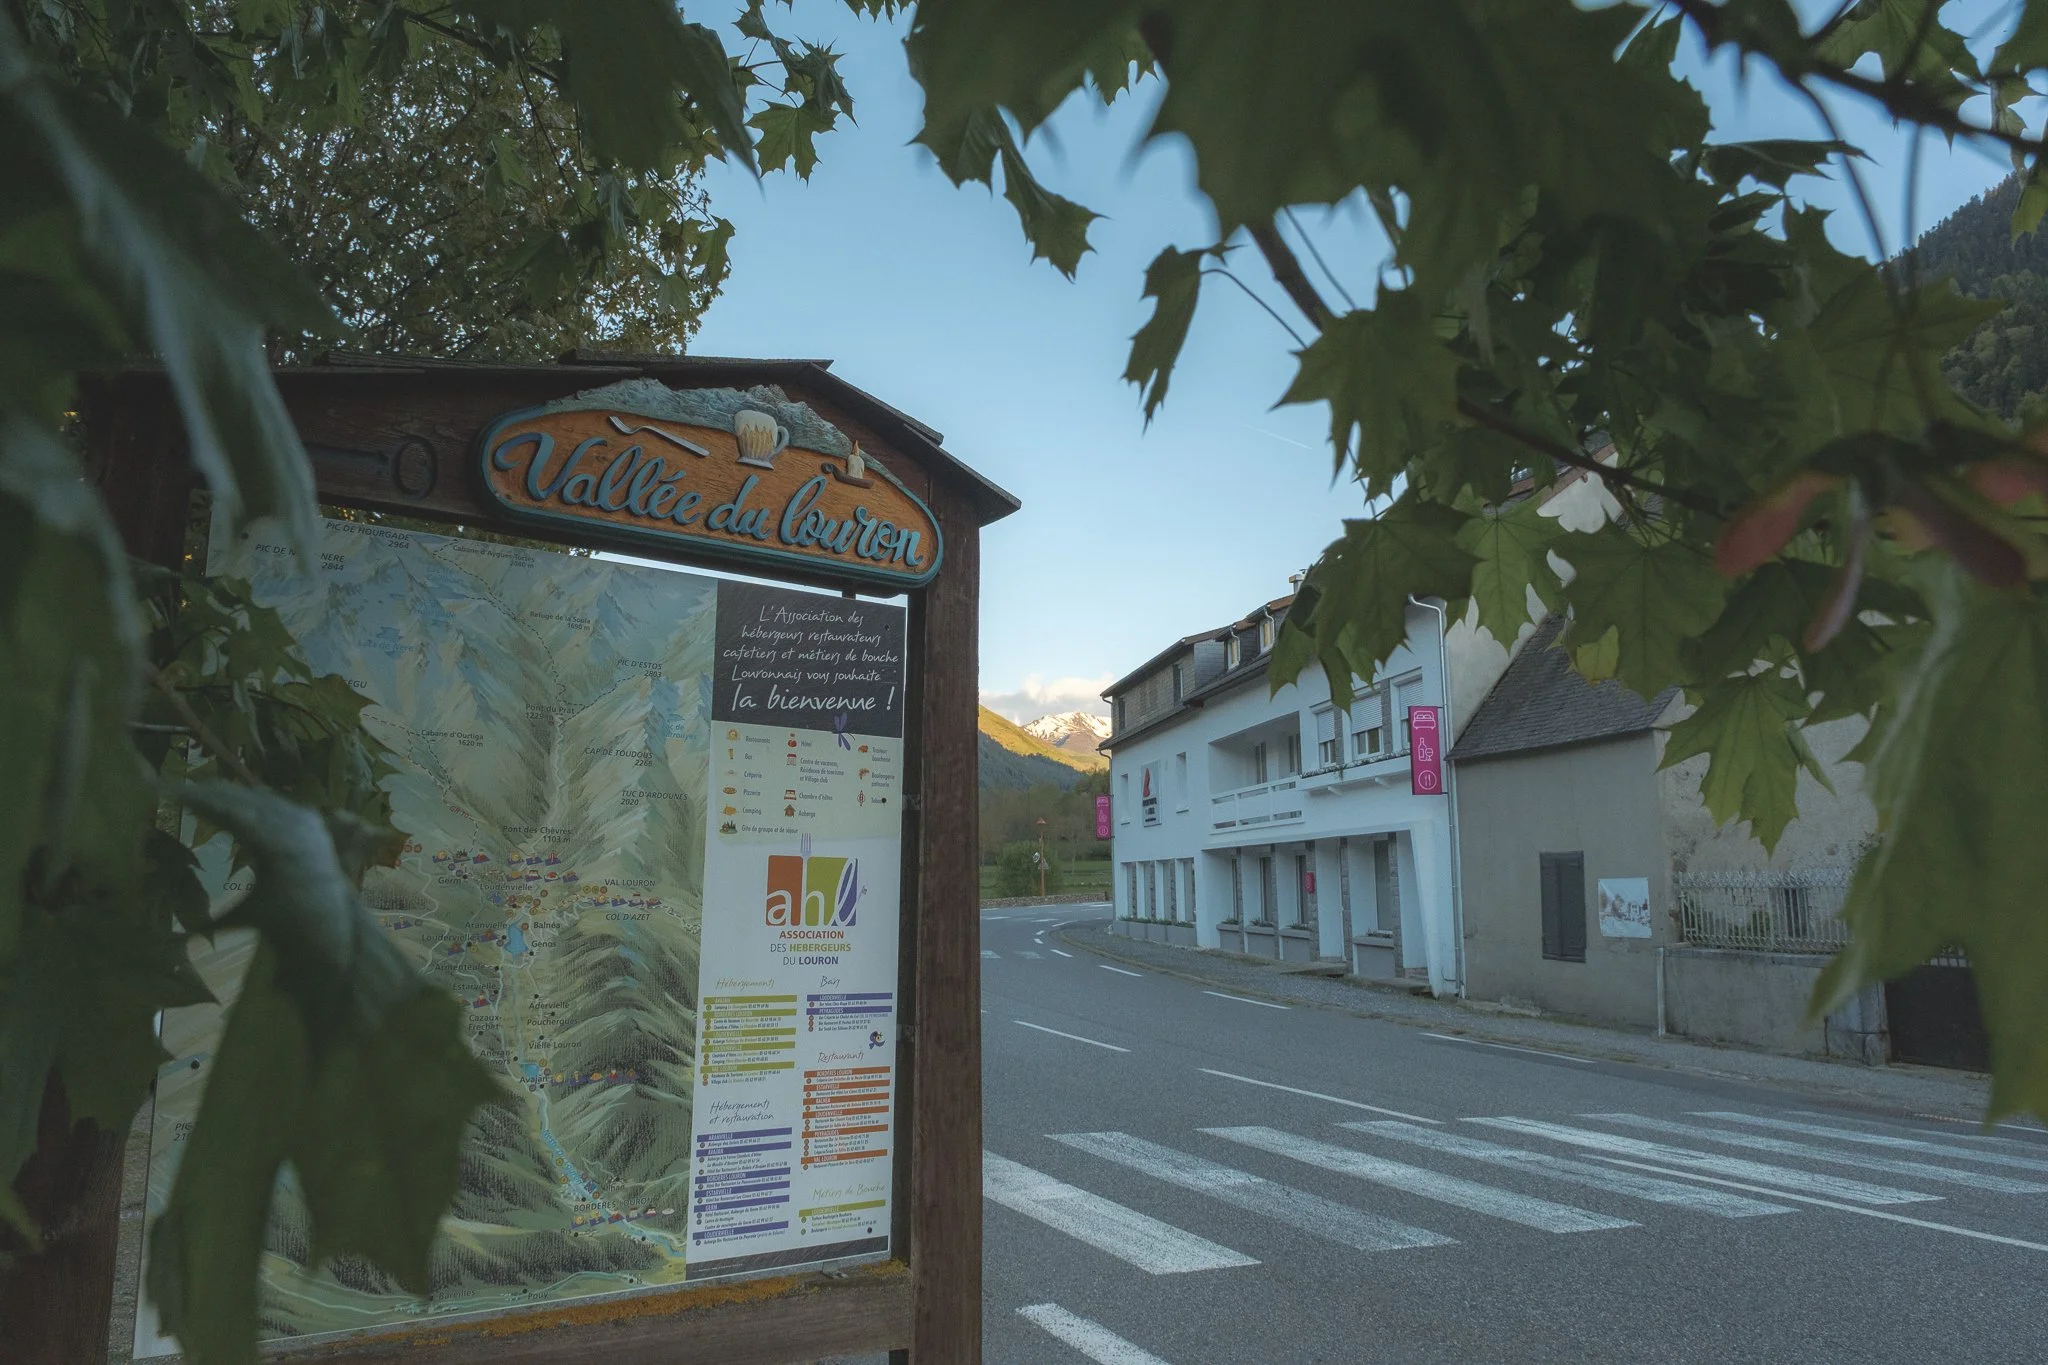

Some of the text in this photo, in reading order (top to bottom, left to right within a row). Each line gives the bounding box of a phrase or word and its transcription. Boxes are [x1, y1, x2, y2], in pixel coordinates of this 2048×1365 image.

[494, 432, 703, 524] Vallée
[708, 474, 772, 540] du
[343, 525, 355, 534] DE
[388, 540, 409, 549] 2964
[273, 546, 286, 554] DE
[848, 610, 864, 628] des
[741, 624, 881, 647] hébergeurs restaurateurs
[781, 647, 795, 660] et
[798, 648, 841, 666] métiers
[845, 649, 857, 662] de
[861, 650, 899, 664] bouche
[806, 671, 830, 684] vous
[833, 668, 881, 685] souhaite
[767, 683, 877, 710] bienvenue
[886, 686, 896, 712] !
[438, 877, 462, 885] Germ
[604, 878, 656, 888] VAL LOURON
[606, 913, 621, 921] COL
[779, 930, 844, 939] ASSOCIATION
[770, 943, 787, 953] DES
[783, 956, 839, 966] DU LOURON
